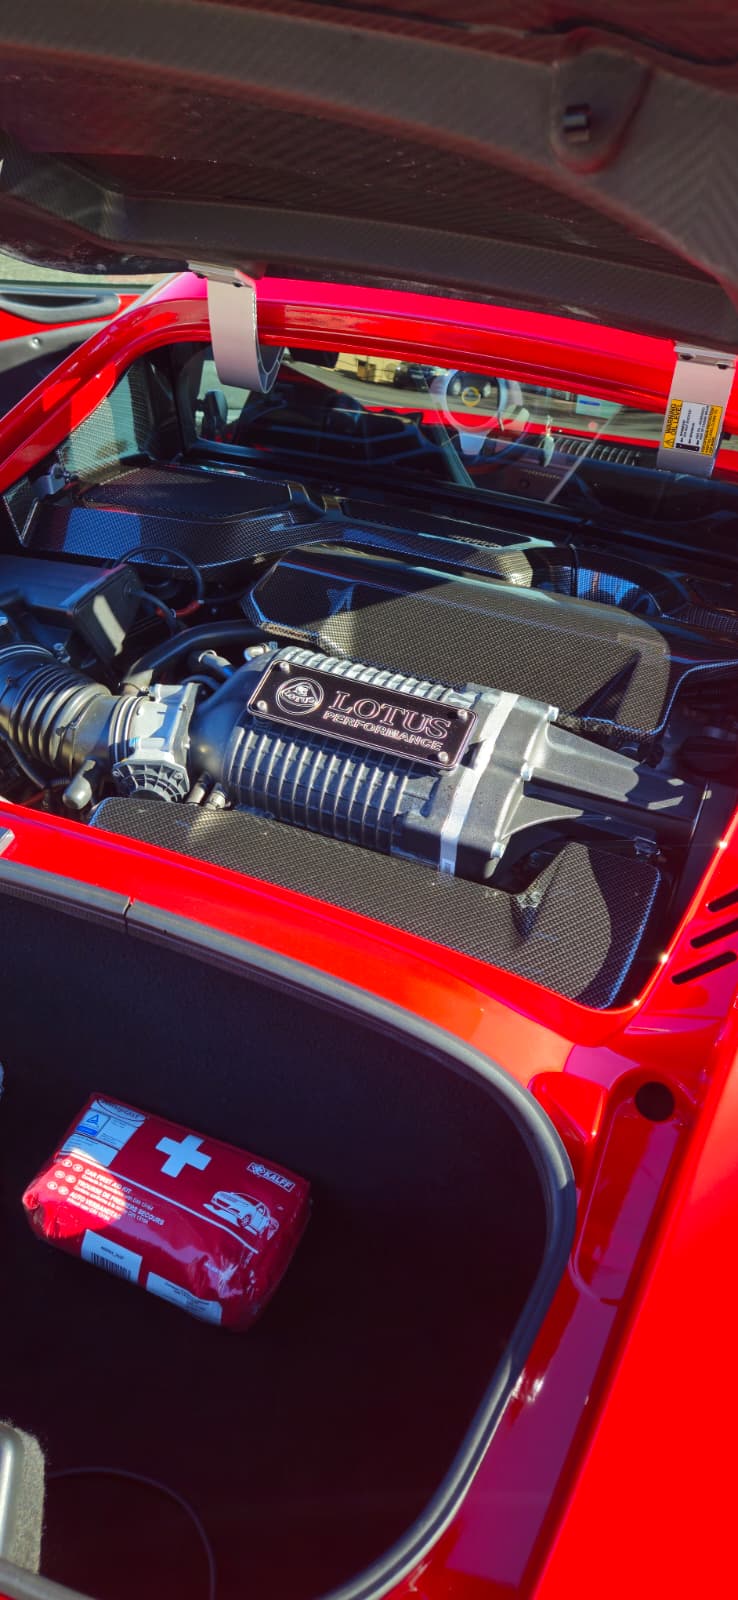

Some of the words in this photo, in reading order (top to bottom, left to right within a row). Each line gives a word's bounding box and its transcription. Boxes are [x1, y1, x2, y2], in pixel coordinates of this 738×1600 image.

[284, 689, 316, 703] LOTUS
[328, 690, 452, 739] LOTUS
[322, 710, 444, 751] PERFORMANCE
[85, 1169, 97, 1178] CAR
[96, 1174, 111, 1185] FIRST
[122, 1186, 132, 1194] KIT
[264, 1170, 294, 1190] KALFF
[70, 1191, 85, 1202] AUTO
